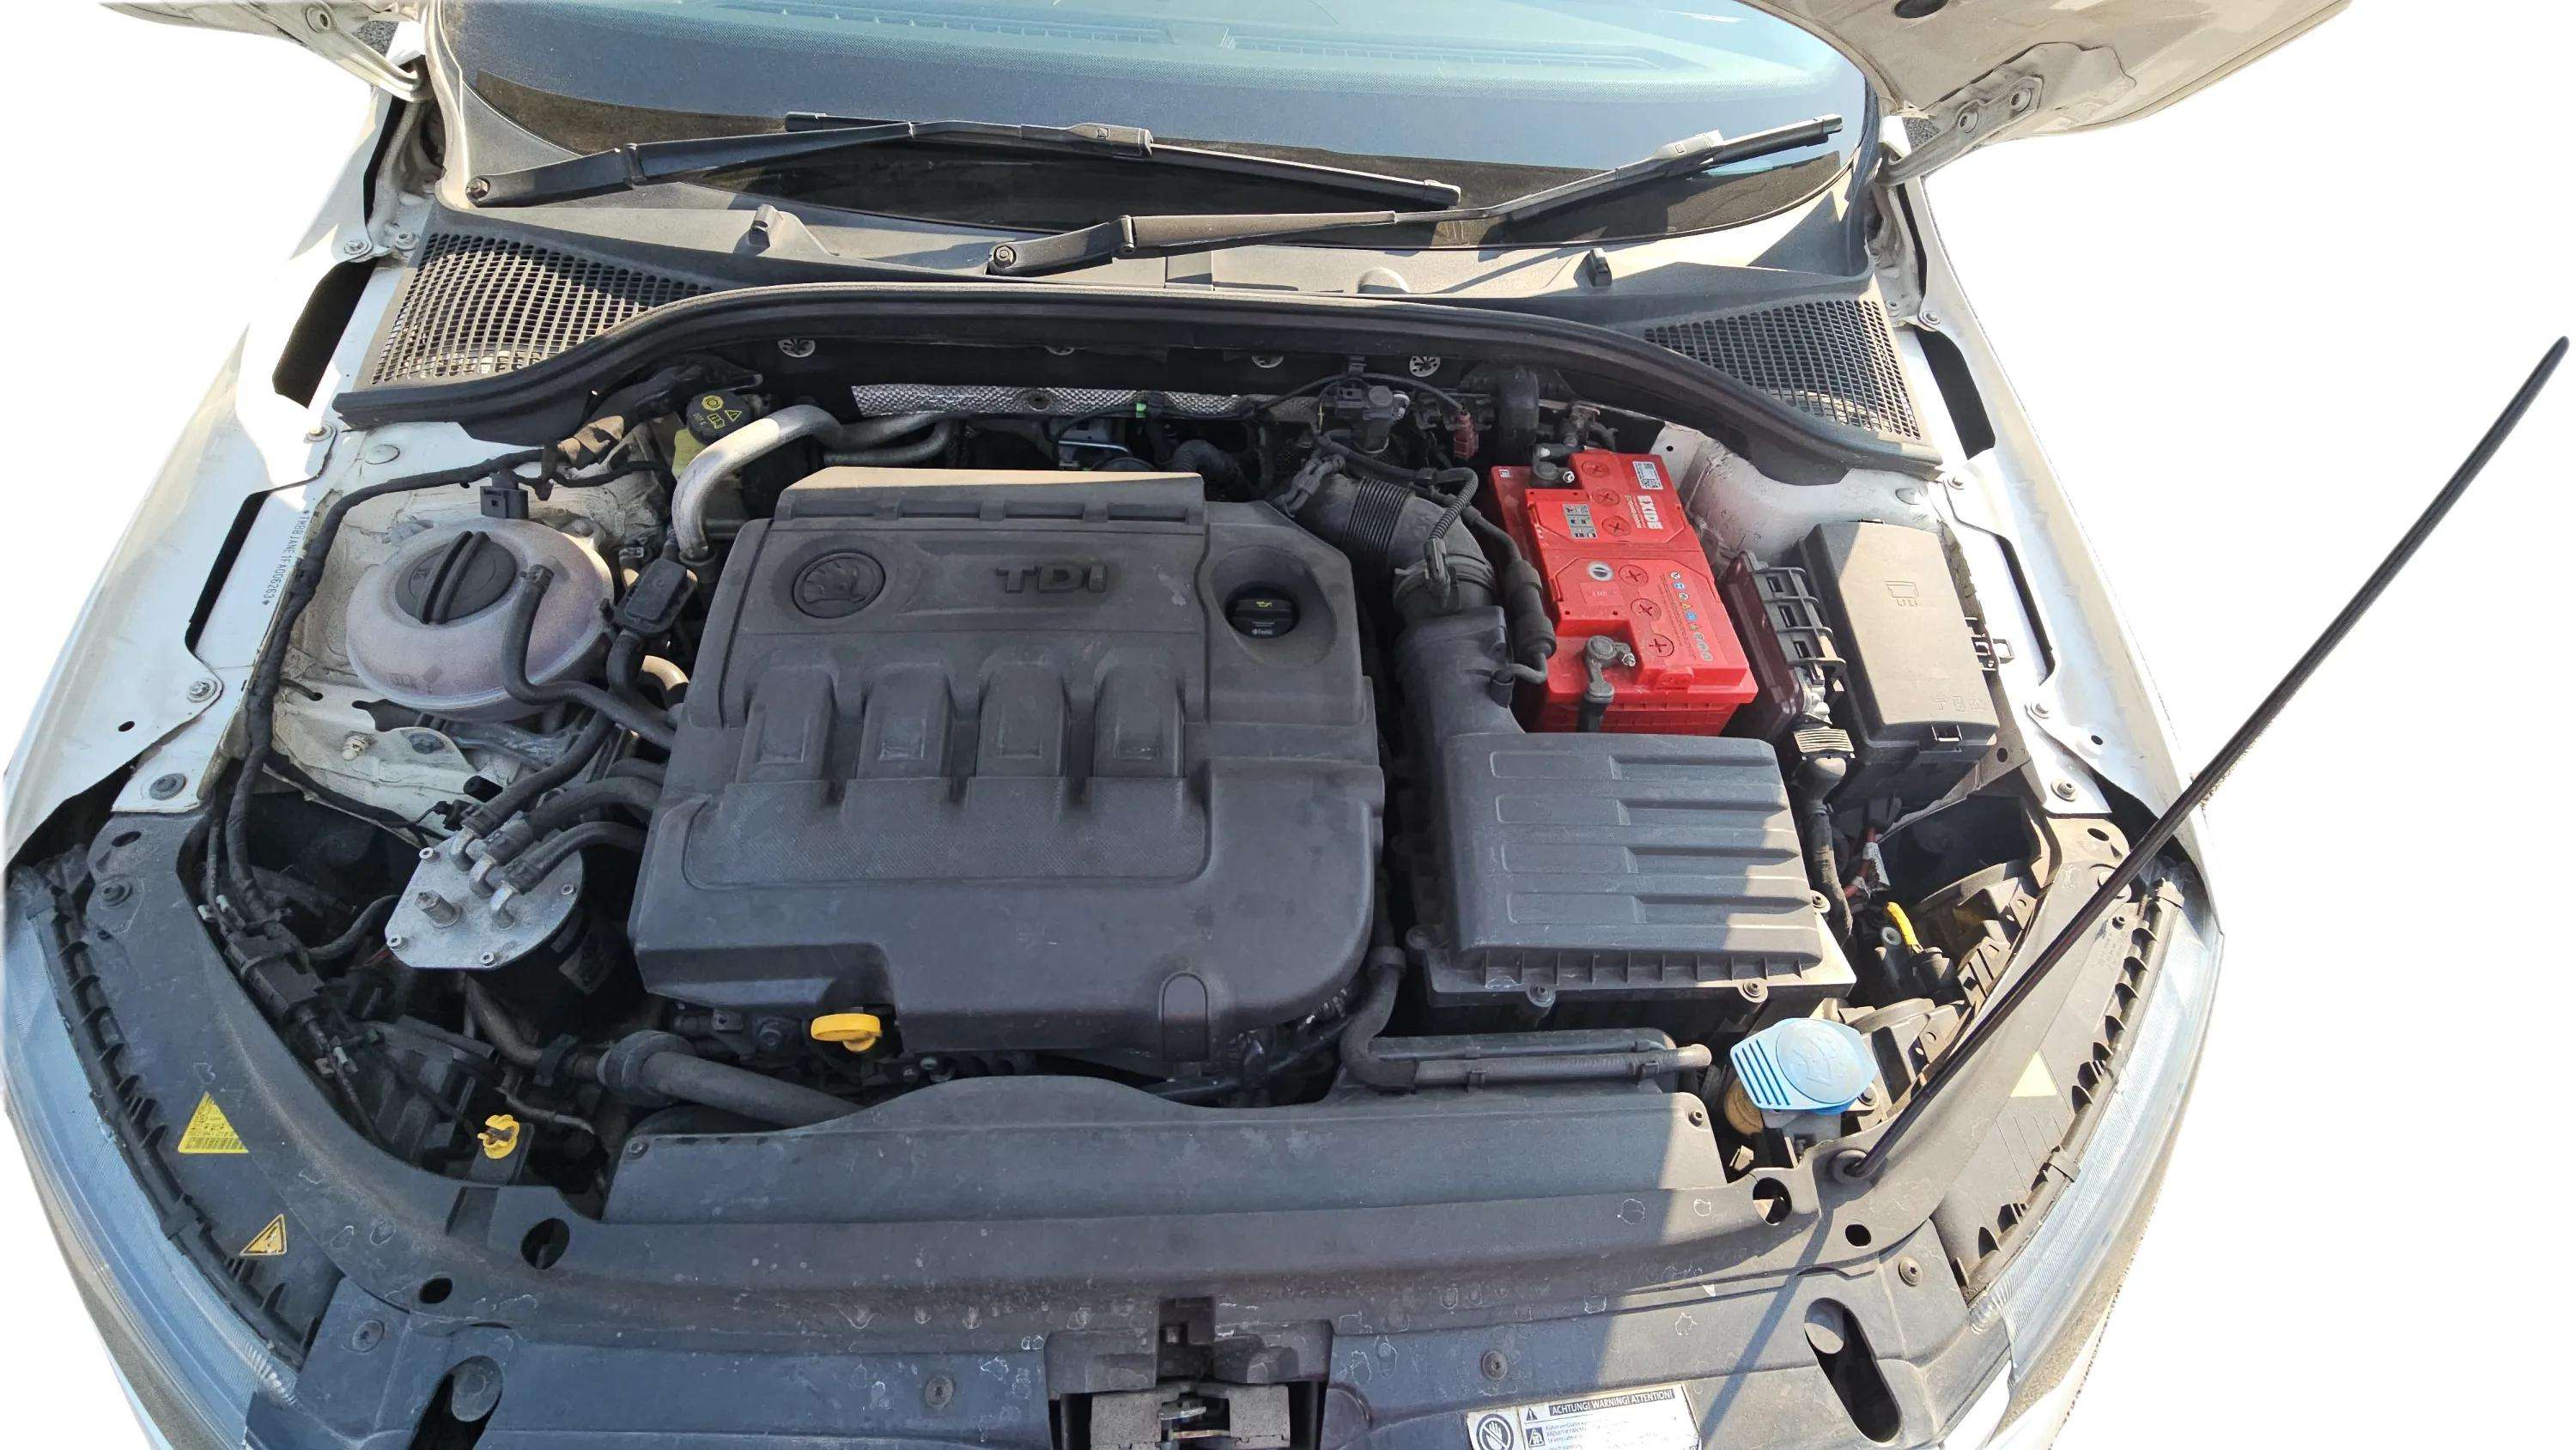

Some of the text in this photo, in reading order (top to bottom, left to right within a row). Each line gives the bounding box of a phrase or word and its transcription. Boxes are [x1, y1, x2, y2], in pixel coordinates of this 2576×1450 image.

[1637, 494, 1663, 529] EXIDE
[995, 562, 1108, 594] TDI
[1552, 1389, 1674, 1415] ACHTUNG! WARNING! ATTENTION!
